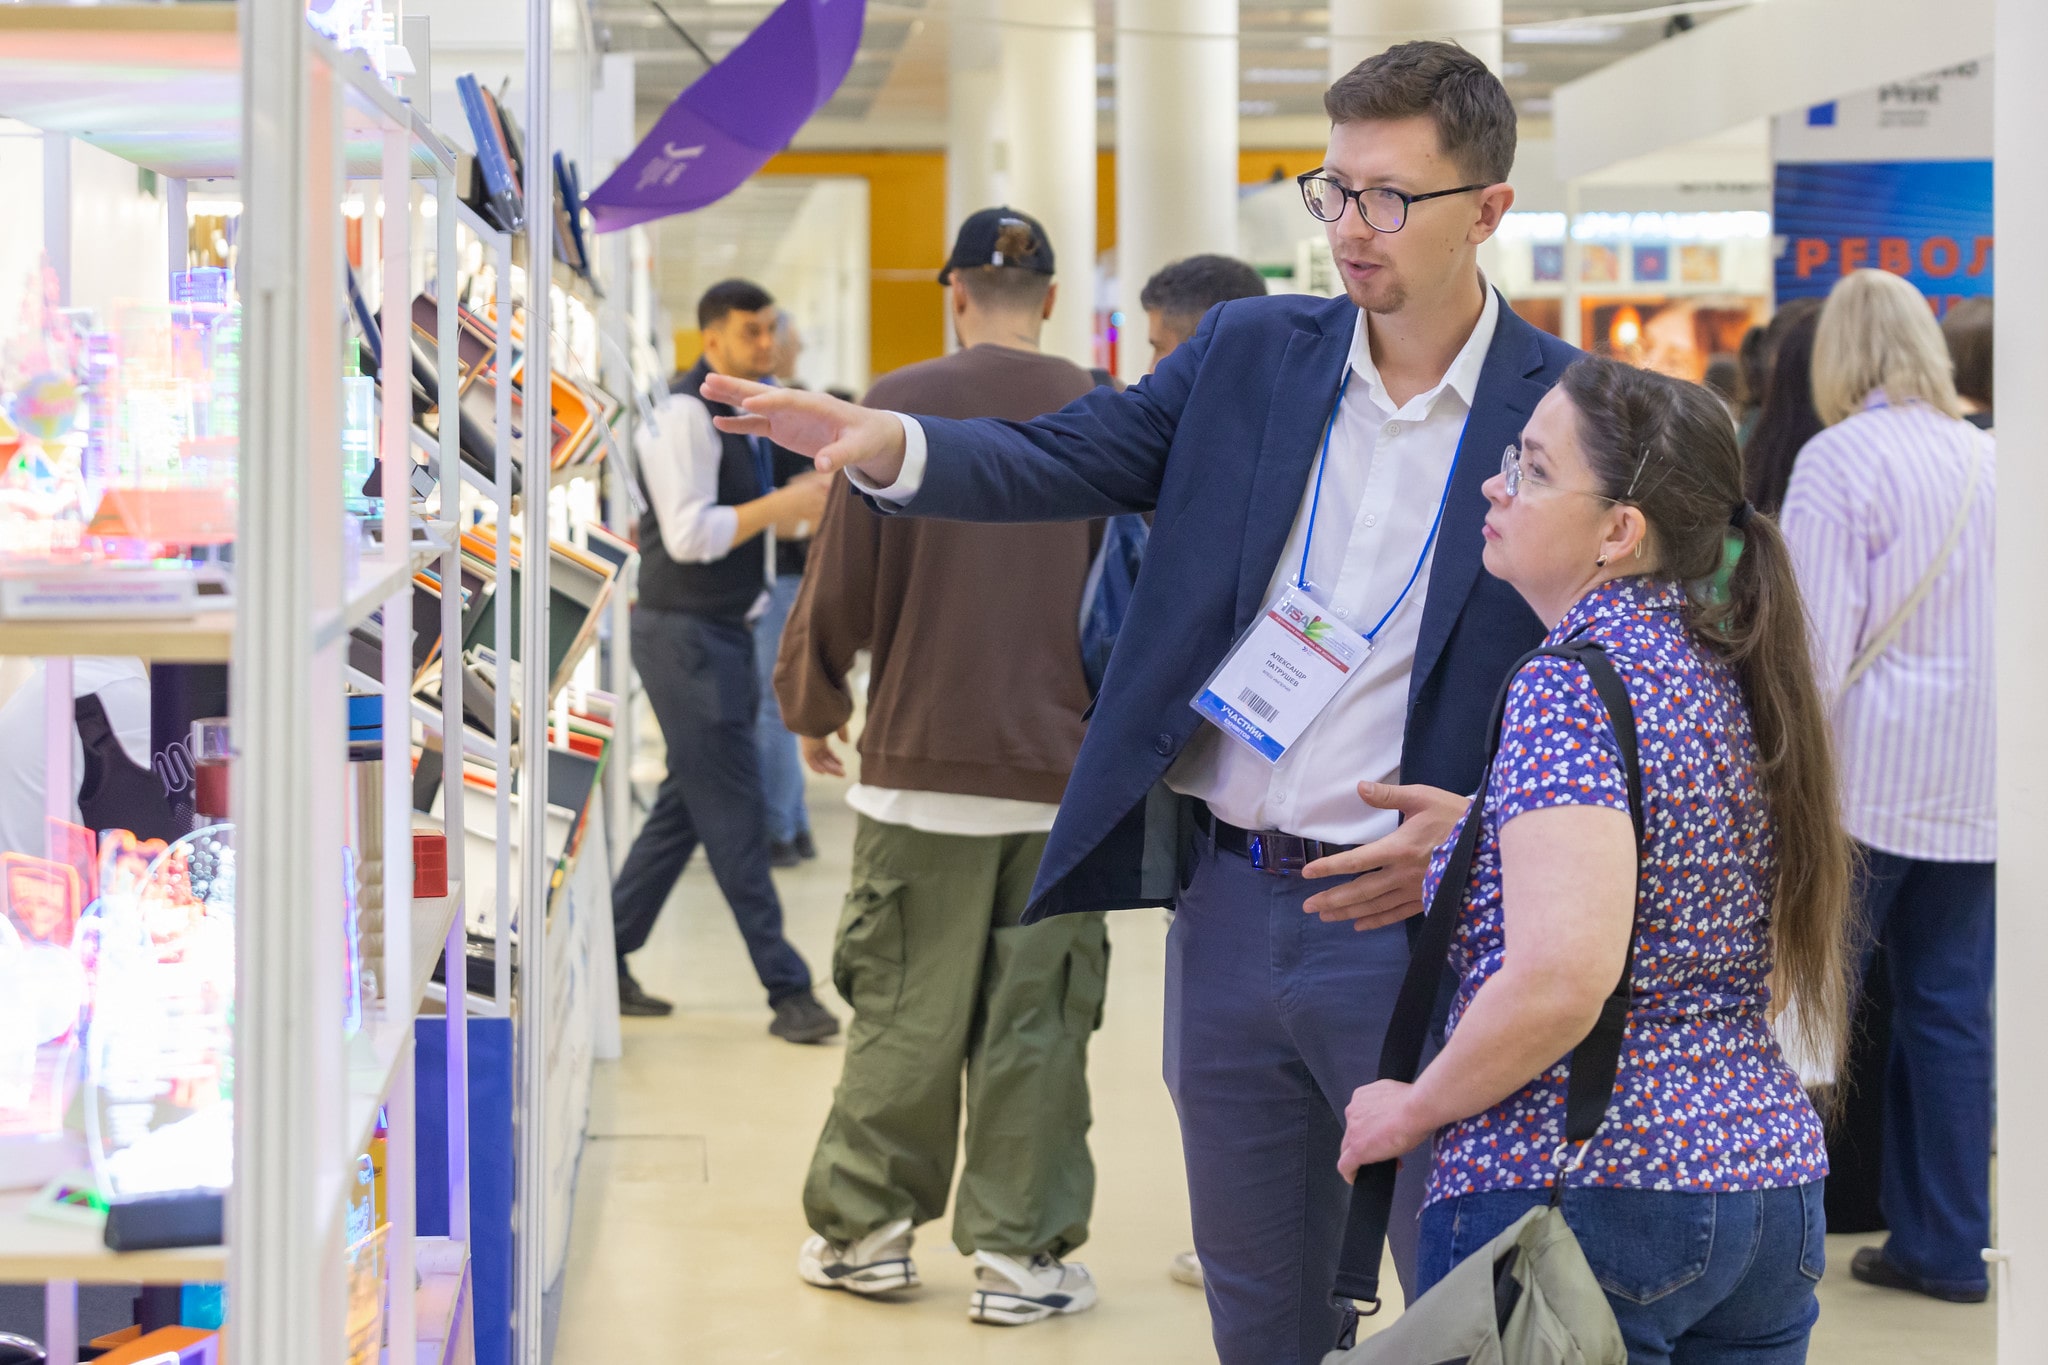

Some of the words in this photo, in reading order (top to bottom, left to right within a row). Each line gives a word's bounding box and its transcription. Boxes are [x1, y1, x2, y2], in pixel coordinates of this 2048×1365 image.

[1265, 659, 1299, 687] ПАТРУШЕВ
[1270, 650, 1306, 680] АЛЕКСАНДР
[1220, 704, 1264, 741] УЧАСТНИК
